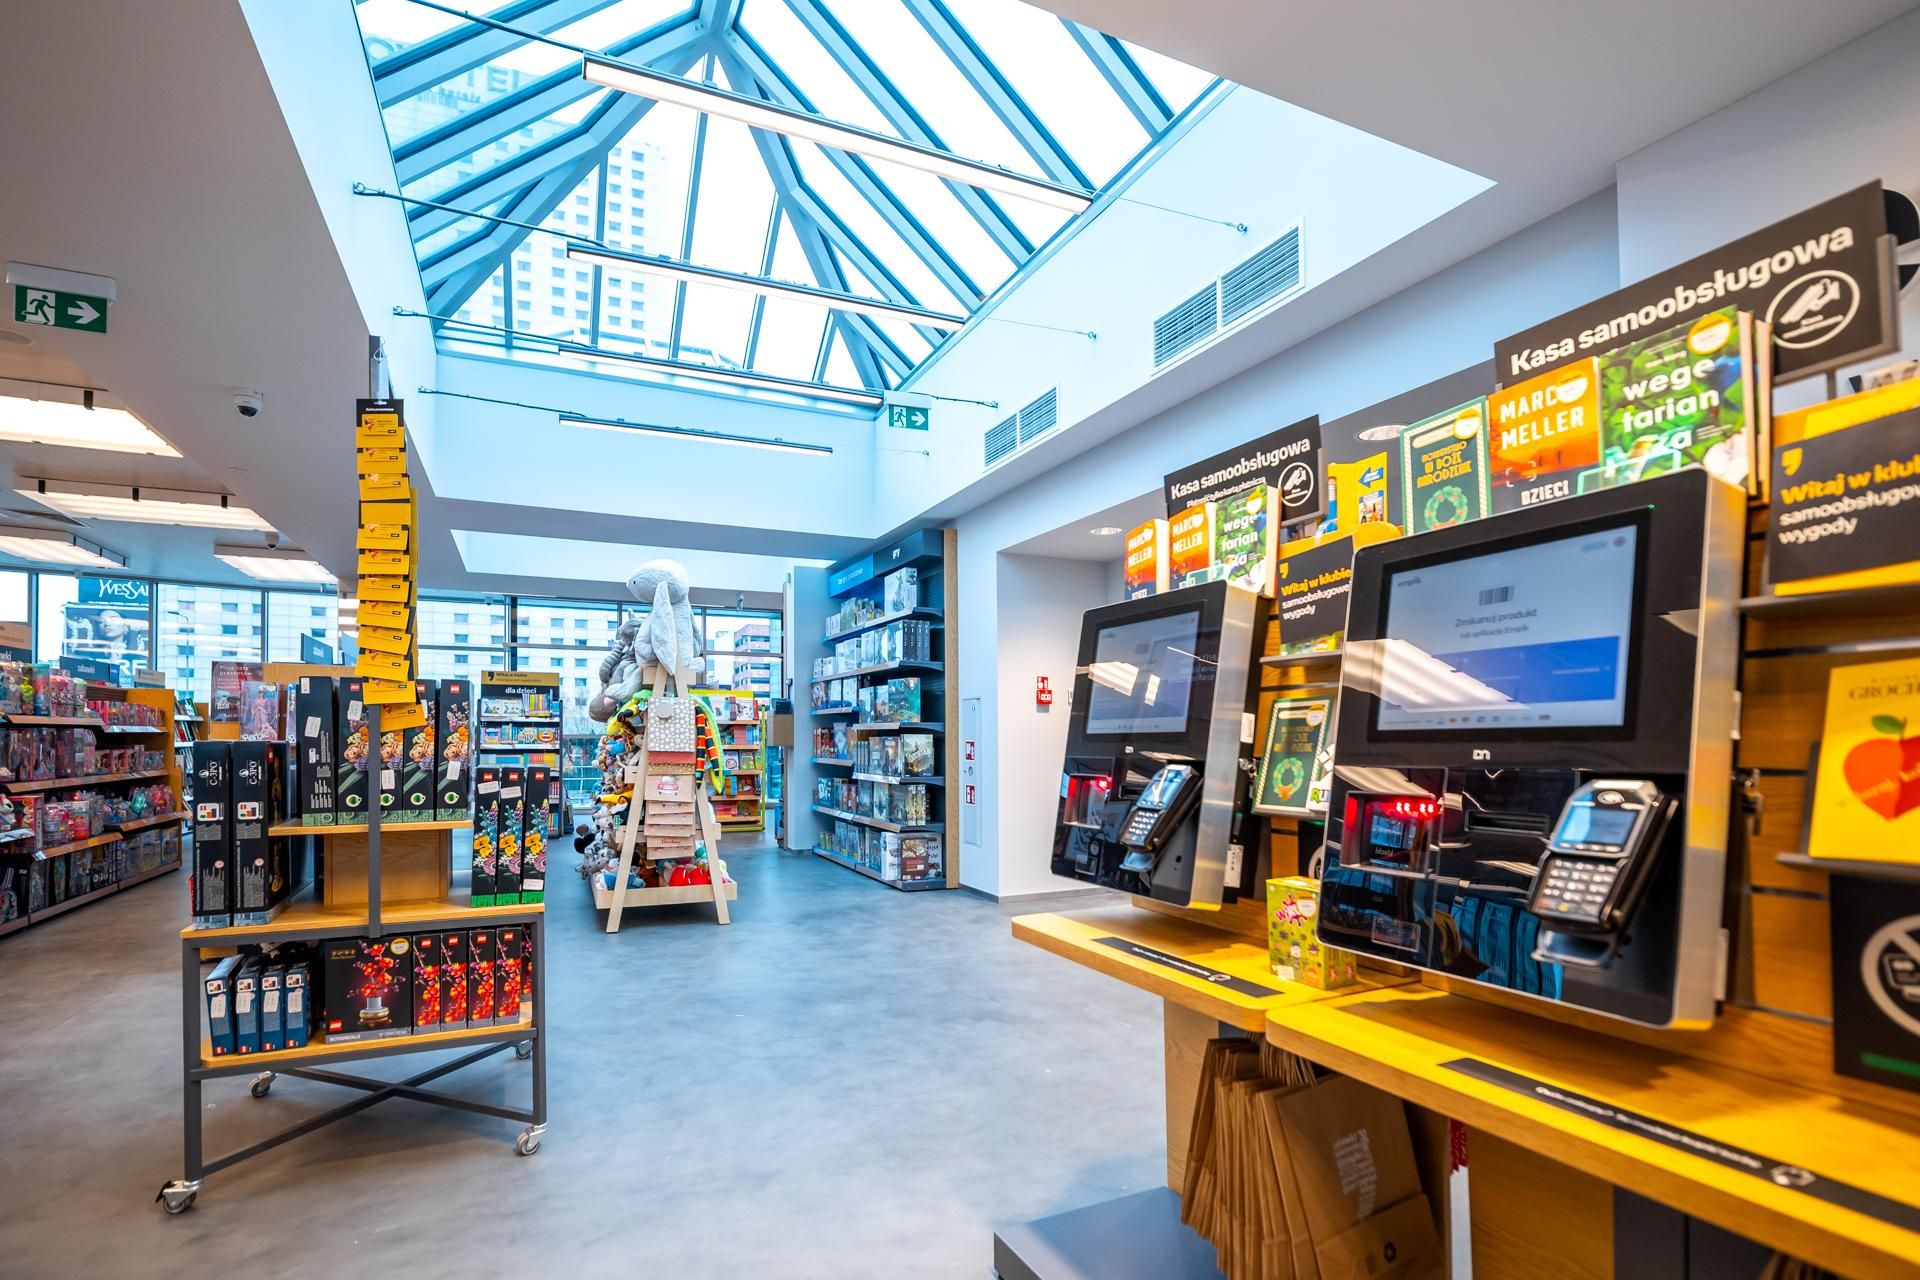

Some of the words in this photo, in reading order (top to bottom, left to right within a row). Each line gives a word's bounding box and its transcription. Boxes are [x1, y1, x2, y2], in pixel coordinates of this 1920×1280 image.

[1510, 337, 1575, 376] Kasa
[1577, 225, 1855, 349] samoobsługowa
[1622, 358, 1717, 402] wege
[1500, 385, 1559, 424] MARC
[1622, 389, 1720, 433] tarian
[1501, 406, 1584, 451] MELLER
[1170, 479, 1200, 500] Kasa
[1200, 438, 1311, 490] samoobsługowa
[1521, 479, 1570, 506] DZIECI
[1780, 473, 1845, 505] Witaj
[1848, 471, 1872, 489] w
[1173, 531, 1204, 555] MELLER
[1222, 531, 1258, 552] tarian
[1778, 516, 1859, 545] wygody
[1128, 546, 1153, 568] MELLER
[1281, 579, 1309, 597] Witaj
[1309, 578, 1319, 588] w
[1319, 567, 1352, 586] klubie
[1282, 581, 1351, 610] samoobsługowe
[1283, 604, 1316, 620] wygody
[517, 687, 537, 695] dzieci
[209, 761, 218, 786] C-3PO
[249, 760, 258, 785] C-3PO
